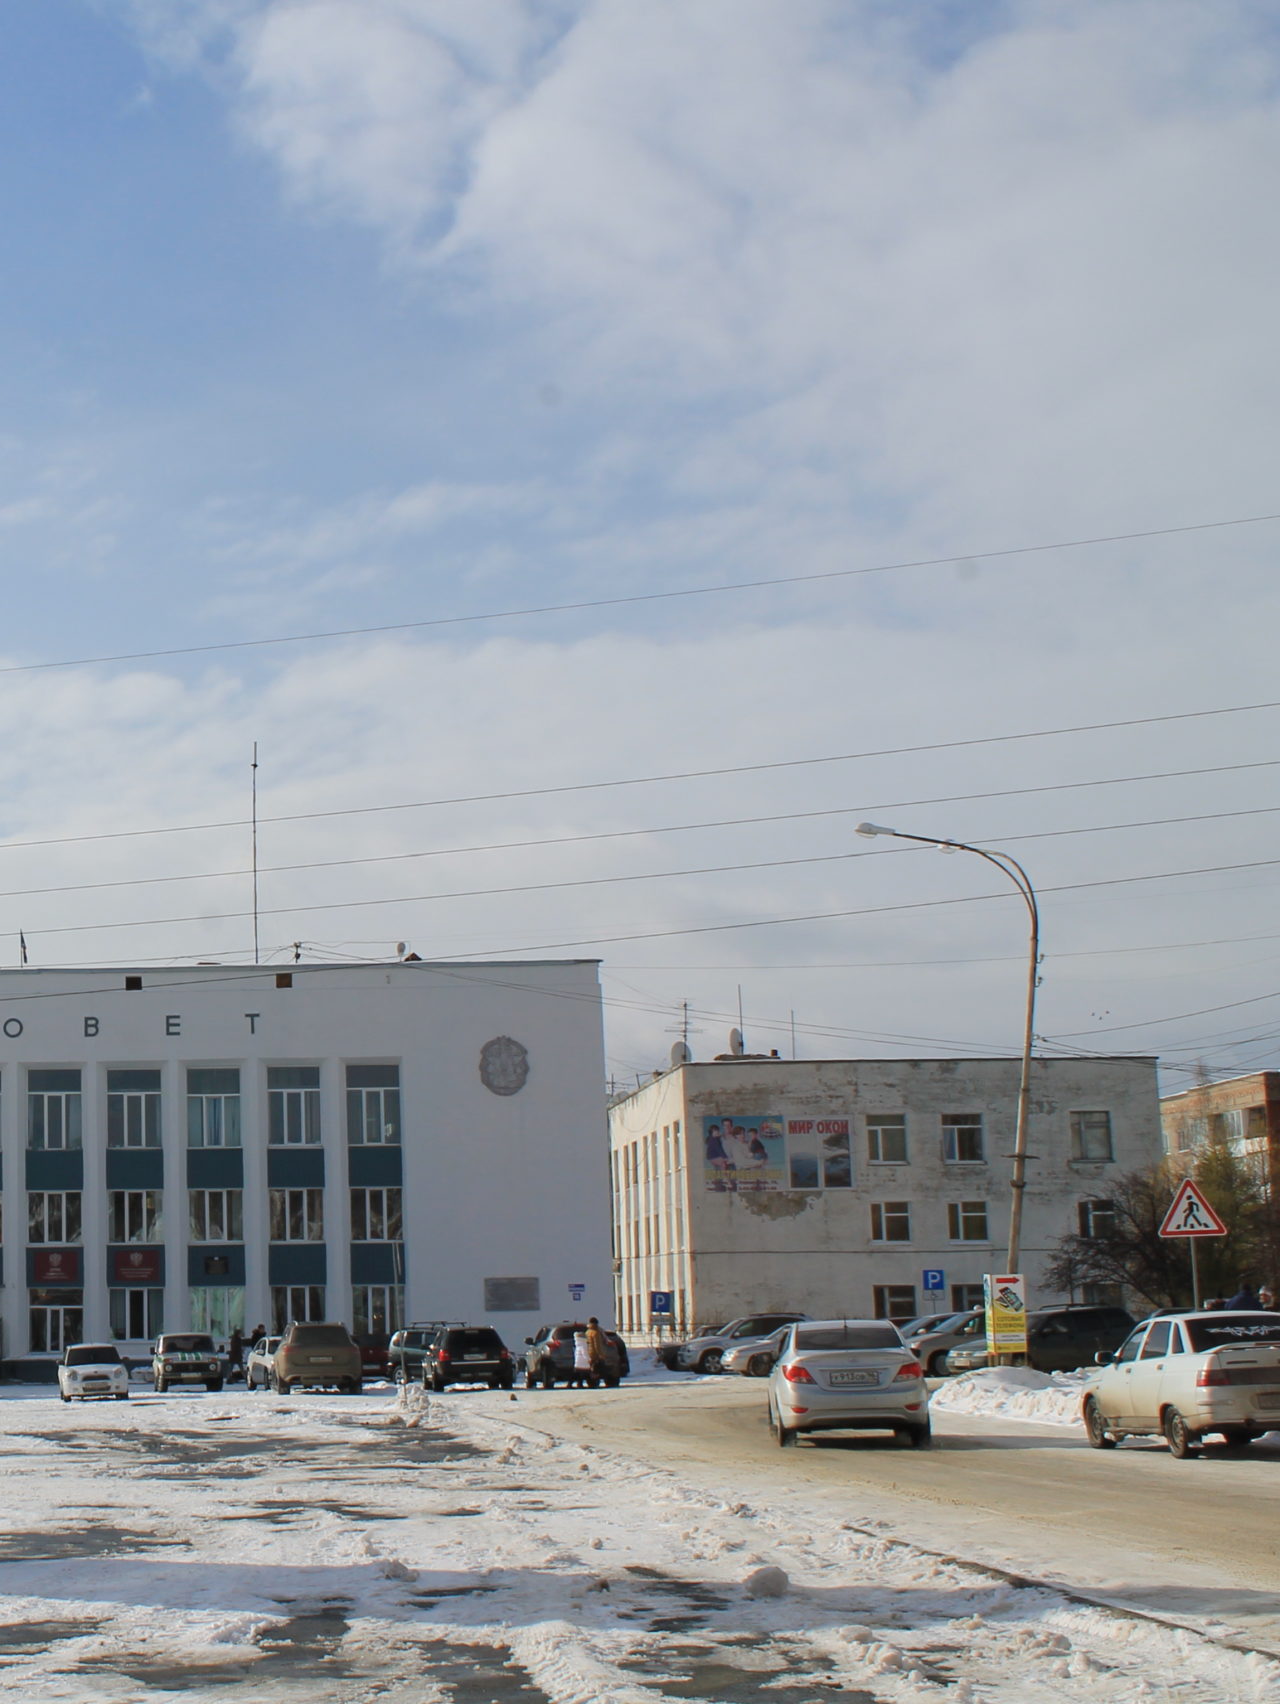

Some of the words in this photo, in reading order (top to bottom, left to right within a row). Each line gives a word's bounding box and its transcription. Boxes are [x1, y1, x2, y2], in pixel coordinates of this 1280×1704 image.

[788, 1120, 813, 1134] МИР
[816, 1120, 849, 1134] ОКОН
[928, 1271, 941, 1289] P
[655, 1294, 666, 1309] P
